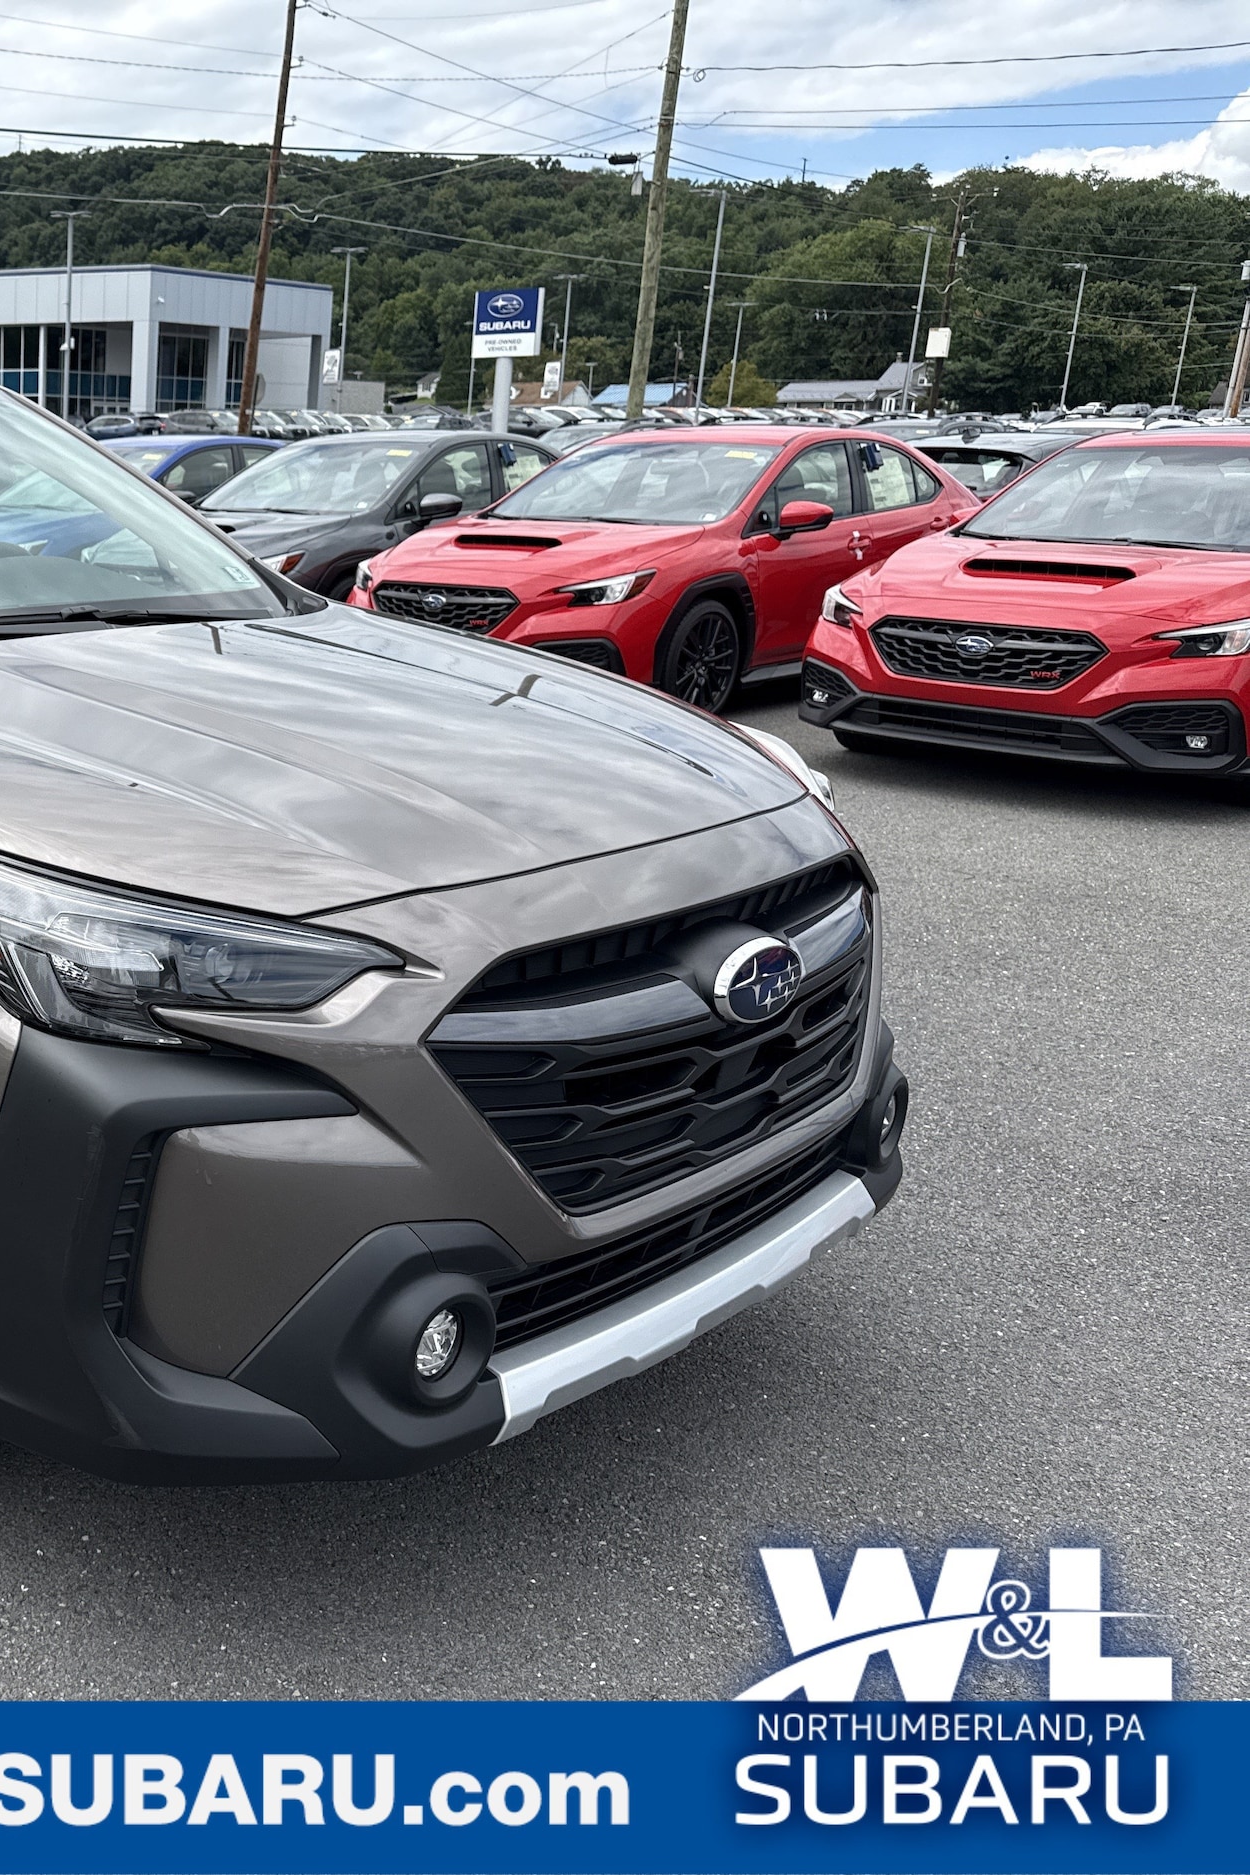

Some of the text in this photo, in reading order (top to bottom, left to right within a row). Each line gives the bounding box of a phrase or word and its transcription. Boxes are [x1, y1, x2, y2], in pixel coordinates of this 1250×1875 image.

[479, 320, 531, 332] SUBARU
[485, 338, 522, 346] PRE-OWNED
[1030, 670, 1061, 679] WRX
